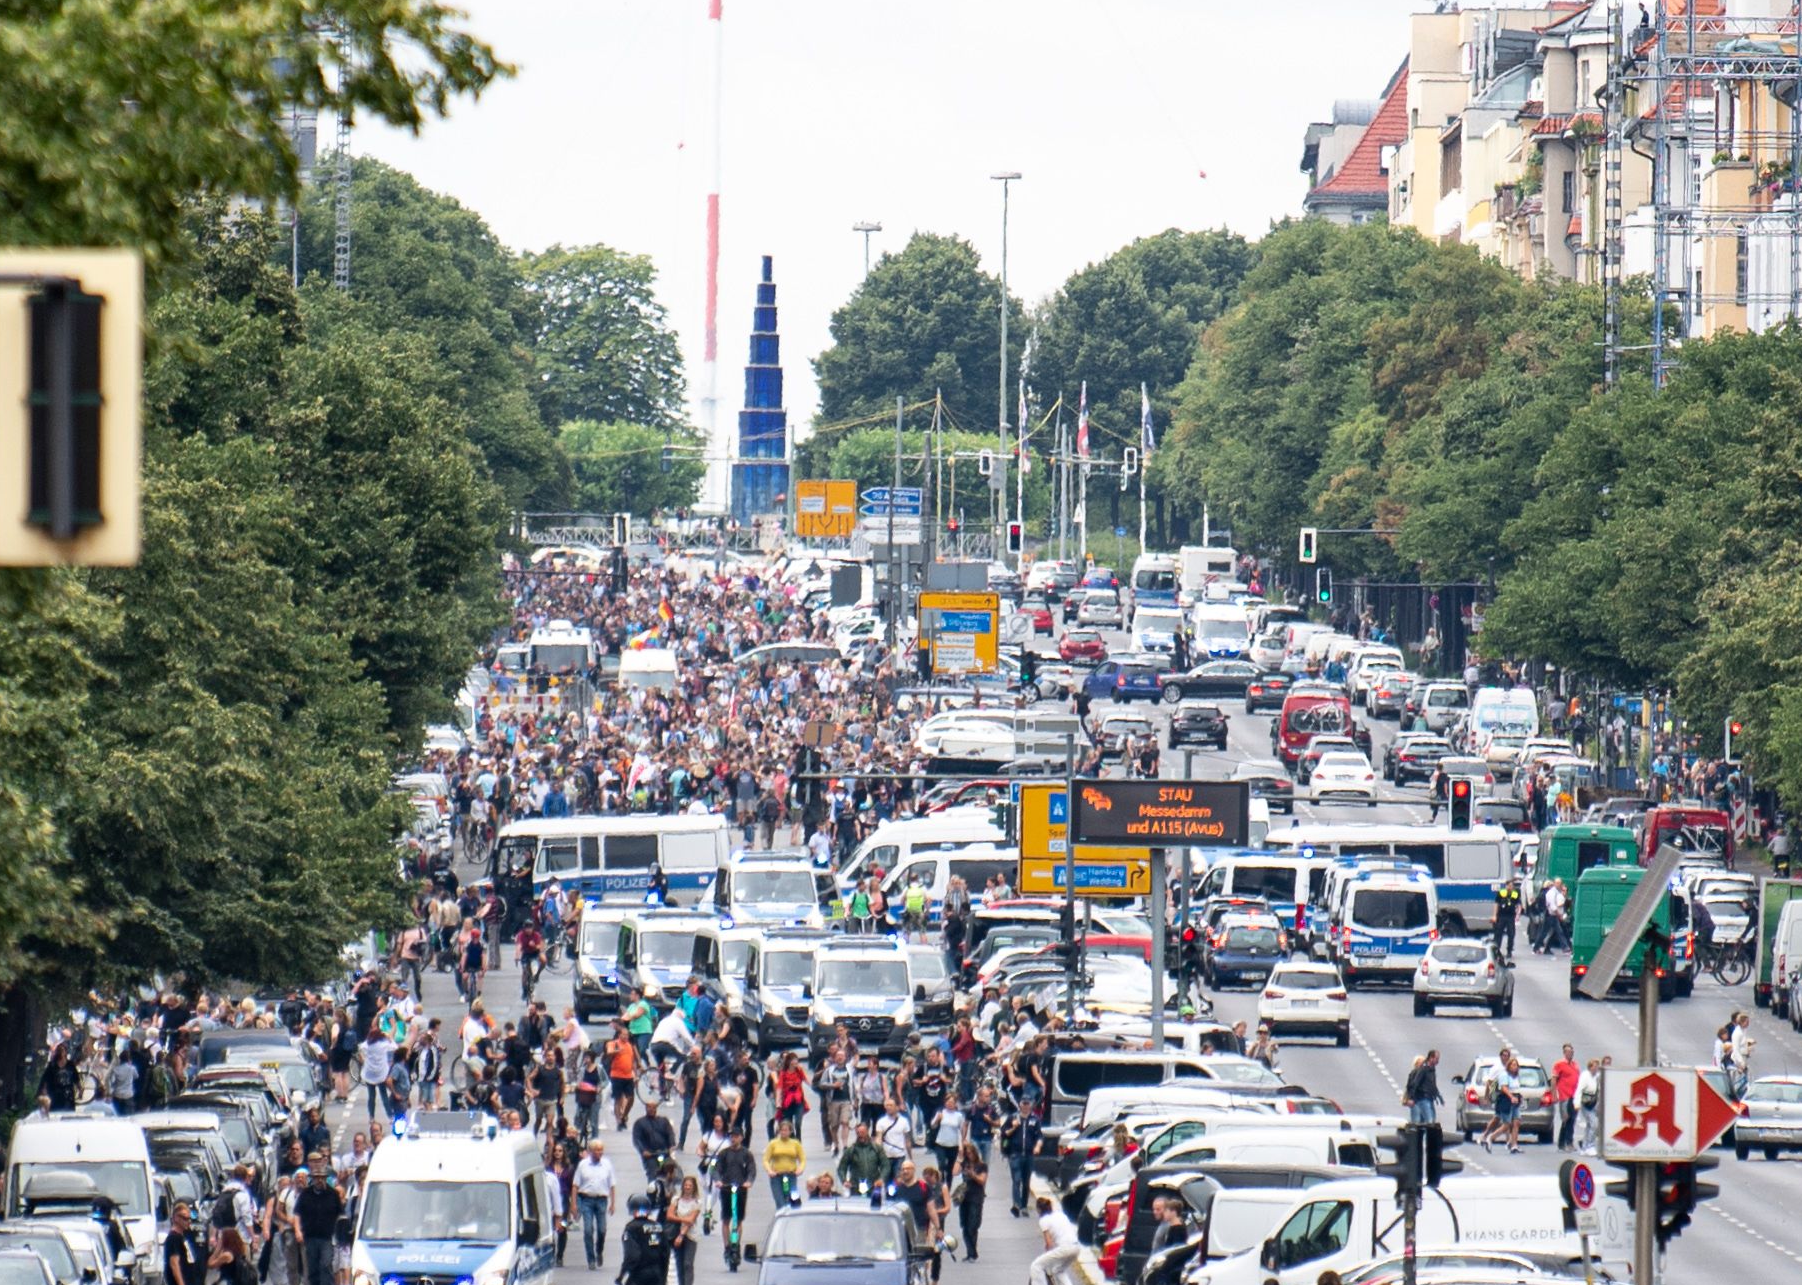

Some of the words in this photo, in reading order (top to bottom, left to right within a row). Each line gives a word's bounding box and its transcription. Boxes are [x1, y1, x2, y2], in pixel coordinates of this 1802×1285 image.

[1158, 787, 1193, 802] STAU
[1138, 803, 1212, 818] Messedamm
[1126, 819, 1149, 834] und
[1151, 820, 1182, 835] A115
[1184, 820, 1224, 837] (Avus)
[1088, 867, 1124, 877] Hamburg
[1353, 945, 1388, 956] POLIZEI
[1465, 1230, 1505, 1242] KIANS
[1510, 1228, 1567, 1241] GARDEN
[396, 1254, 461, 1265] POLIZEI
